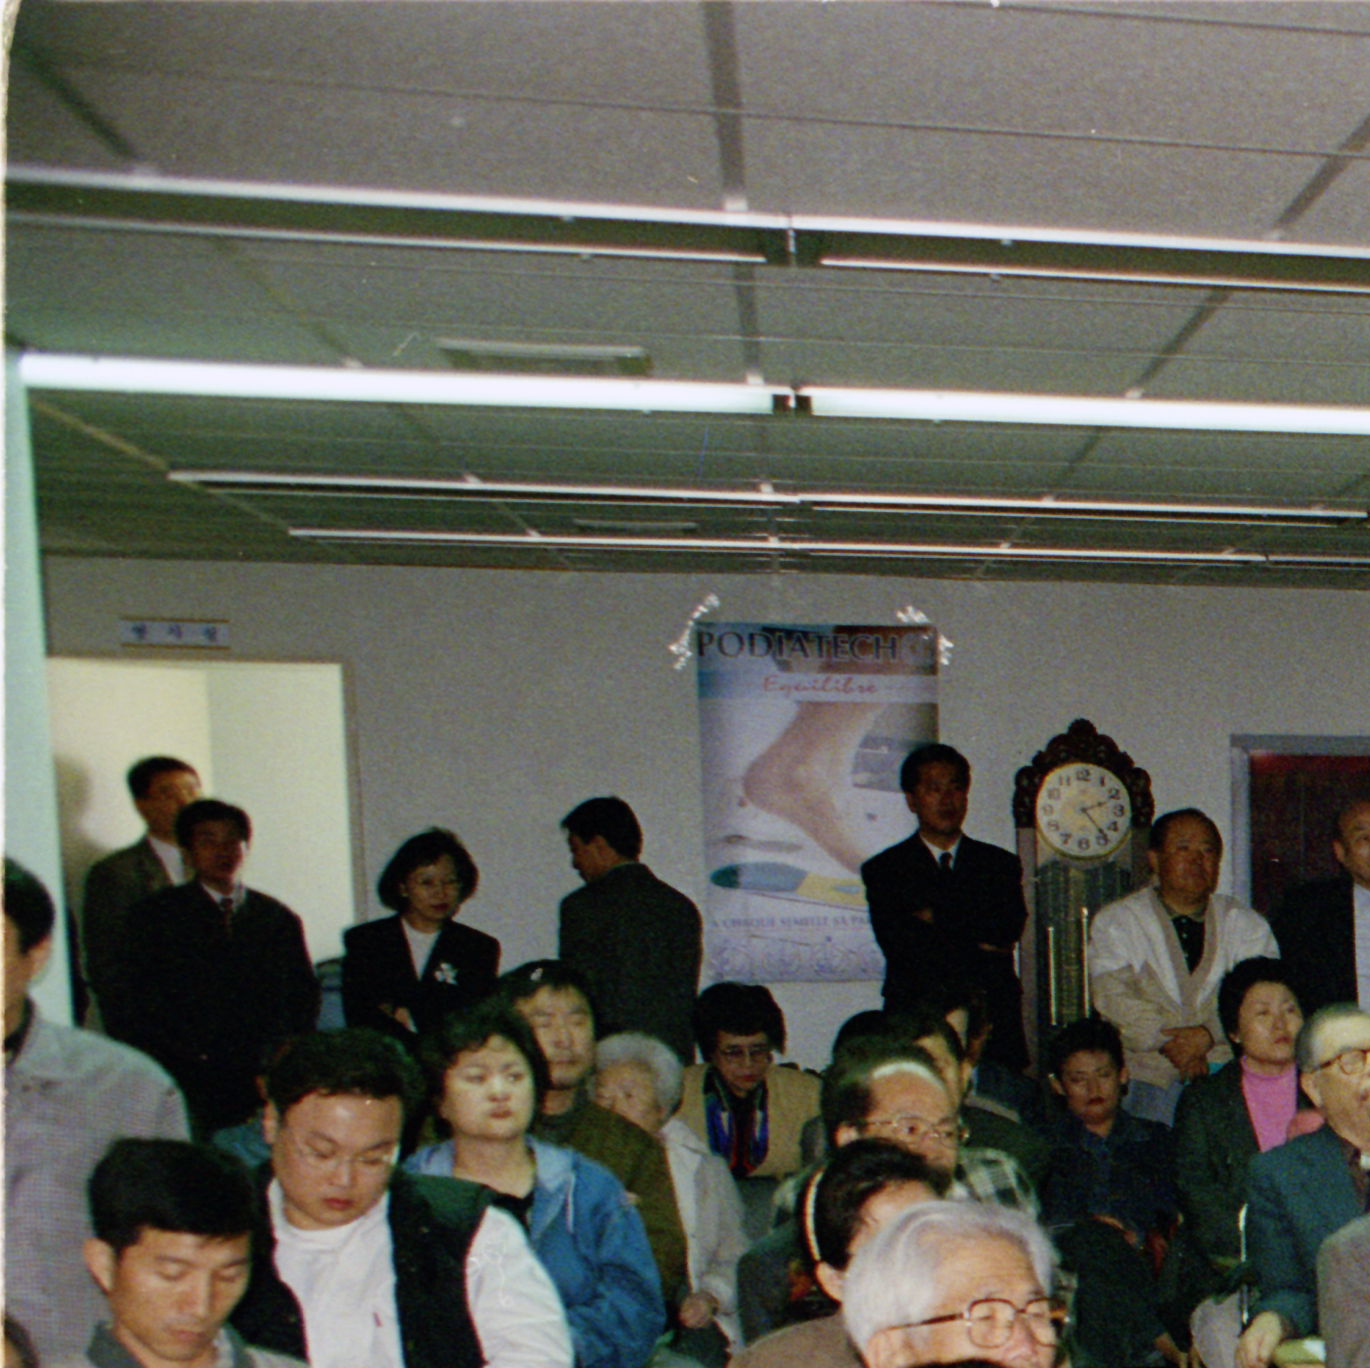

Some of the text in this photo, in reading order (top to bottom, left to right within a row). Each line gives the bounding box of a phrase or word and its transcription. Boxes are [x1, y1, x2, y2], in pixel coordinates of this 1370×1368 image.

[697, 631, 898, 661] PODIATECH
[763, 674, 878, 697] Equilibre
[1059, 775, 1070, 786] 11
[1076, 769, 1090, 782] 12
[1108, 788, 1120, 800] 2
[1114, 804, 1125, 817] 3
[1108, 821, 1119, 832] 4
[1061, 833, 1072, 845] 7
[1078, 838, 1090, 850] 6
